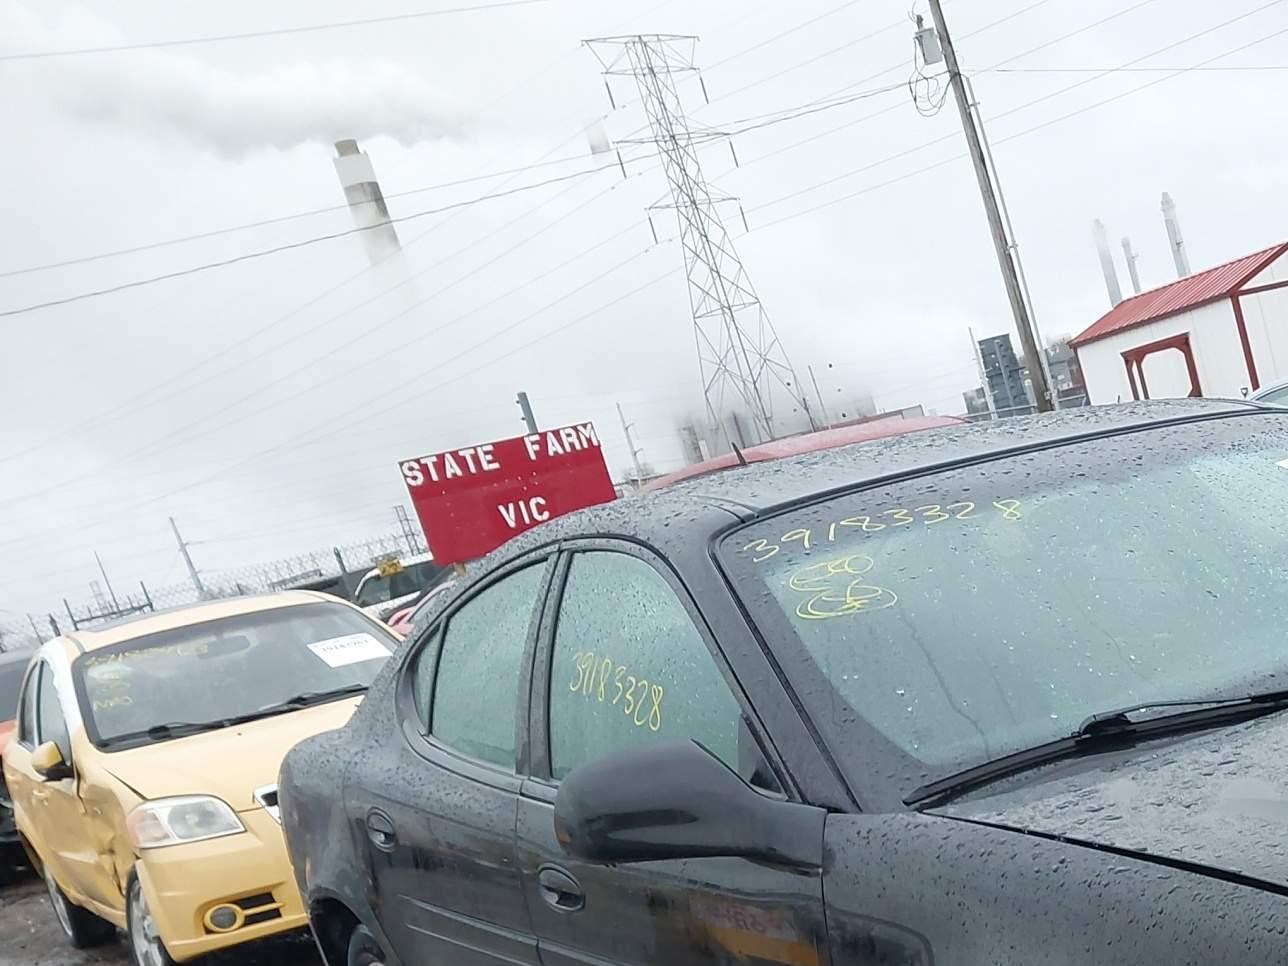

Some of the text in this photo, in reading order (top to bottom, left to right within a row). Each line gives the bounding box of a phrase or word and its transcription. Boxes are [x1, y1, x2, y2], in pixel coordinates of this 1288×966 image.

[401, 422, 601, 487] STATE FARM
[497, 496, 551, 529] VIC
[743, 500, 1022, 562] 39183328
